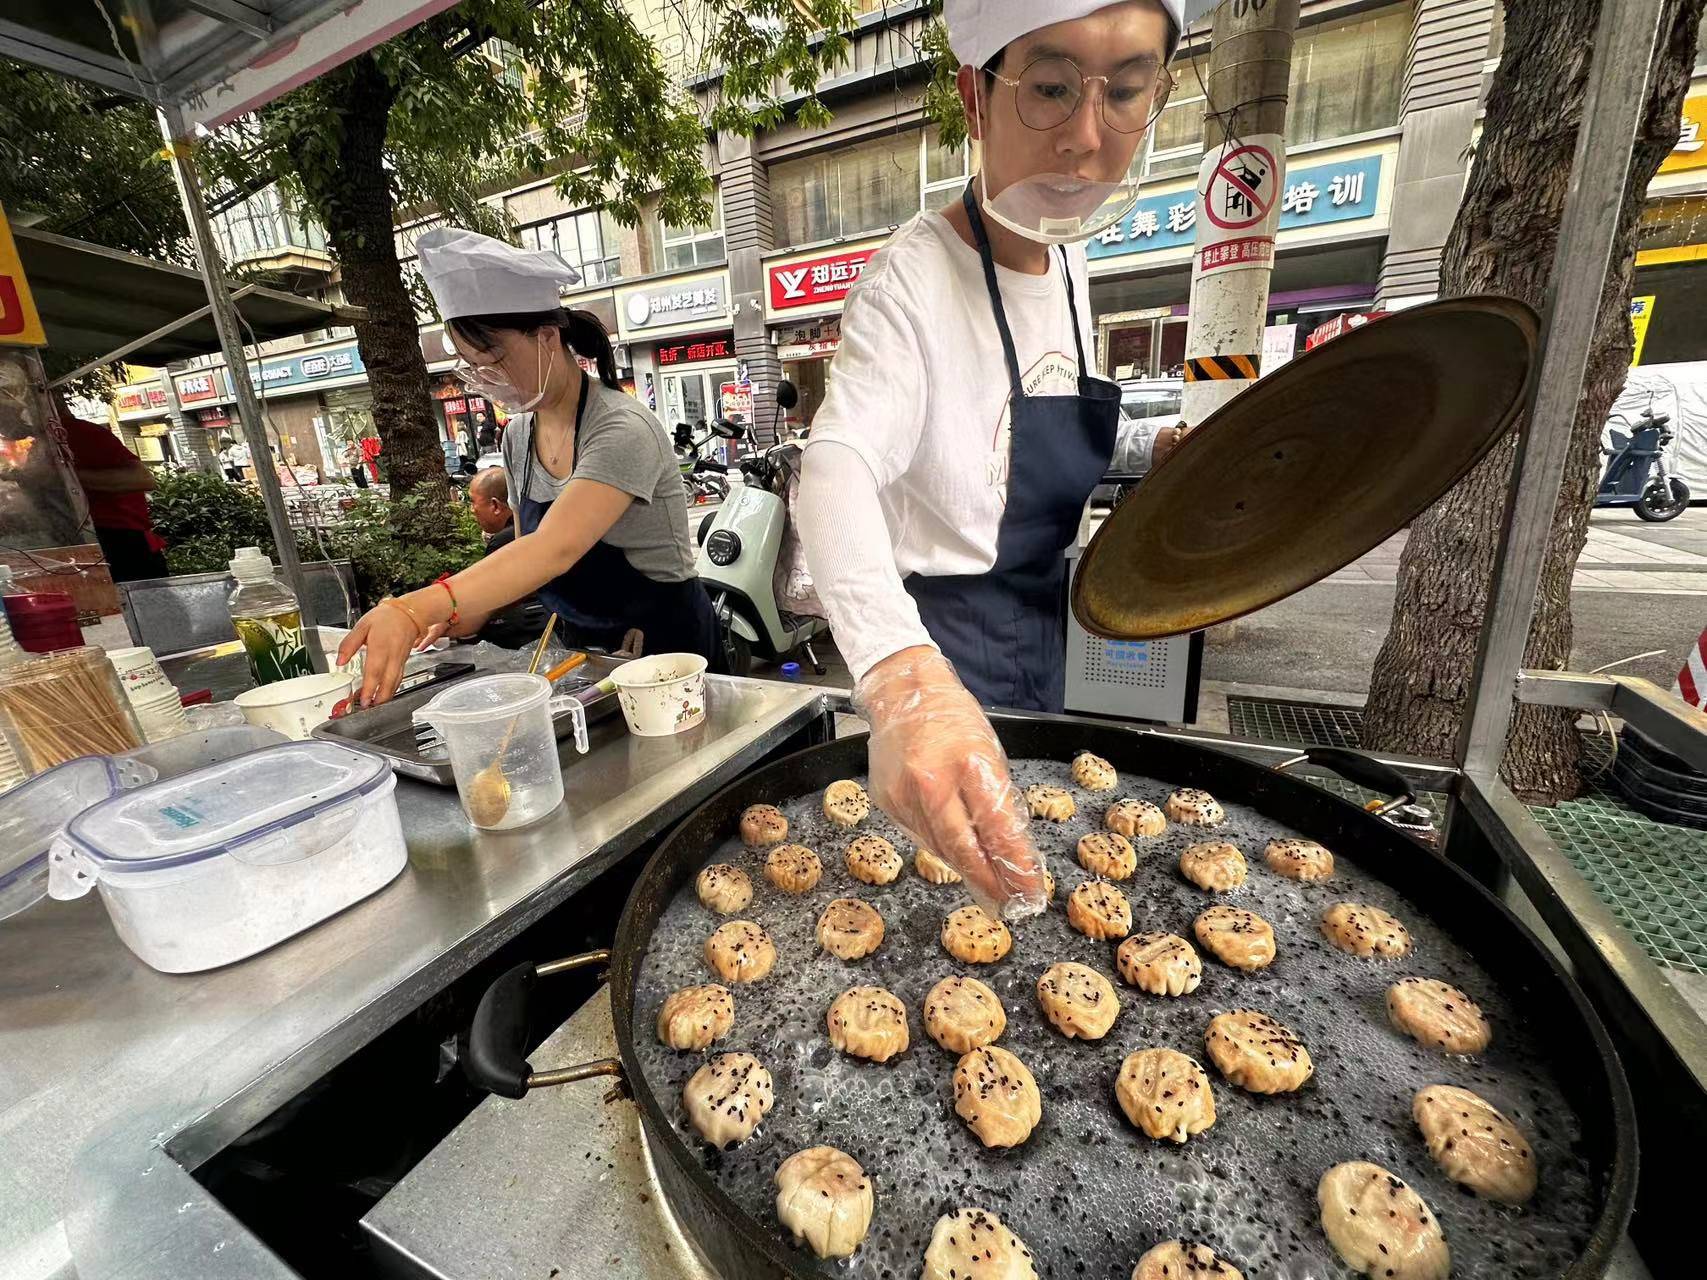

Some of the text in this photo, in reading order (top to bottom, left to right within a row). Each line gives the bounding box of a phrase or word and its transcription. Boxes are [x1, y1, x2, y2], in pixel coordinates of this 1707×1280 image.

[1281, 171, 1365, 213] 培训
[1203, 243, 1239, 267] 禁止攀登
[811, 257, 867, 285] 郑远元
